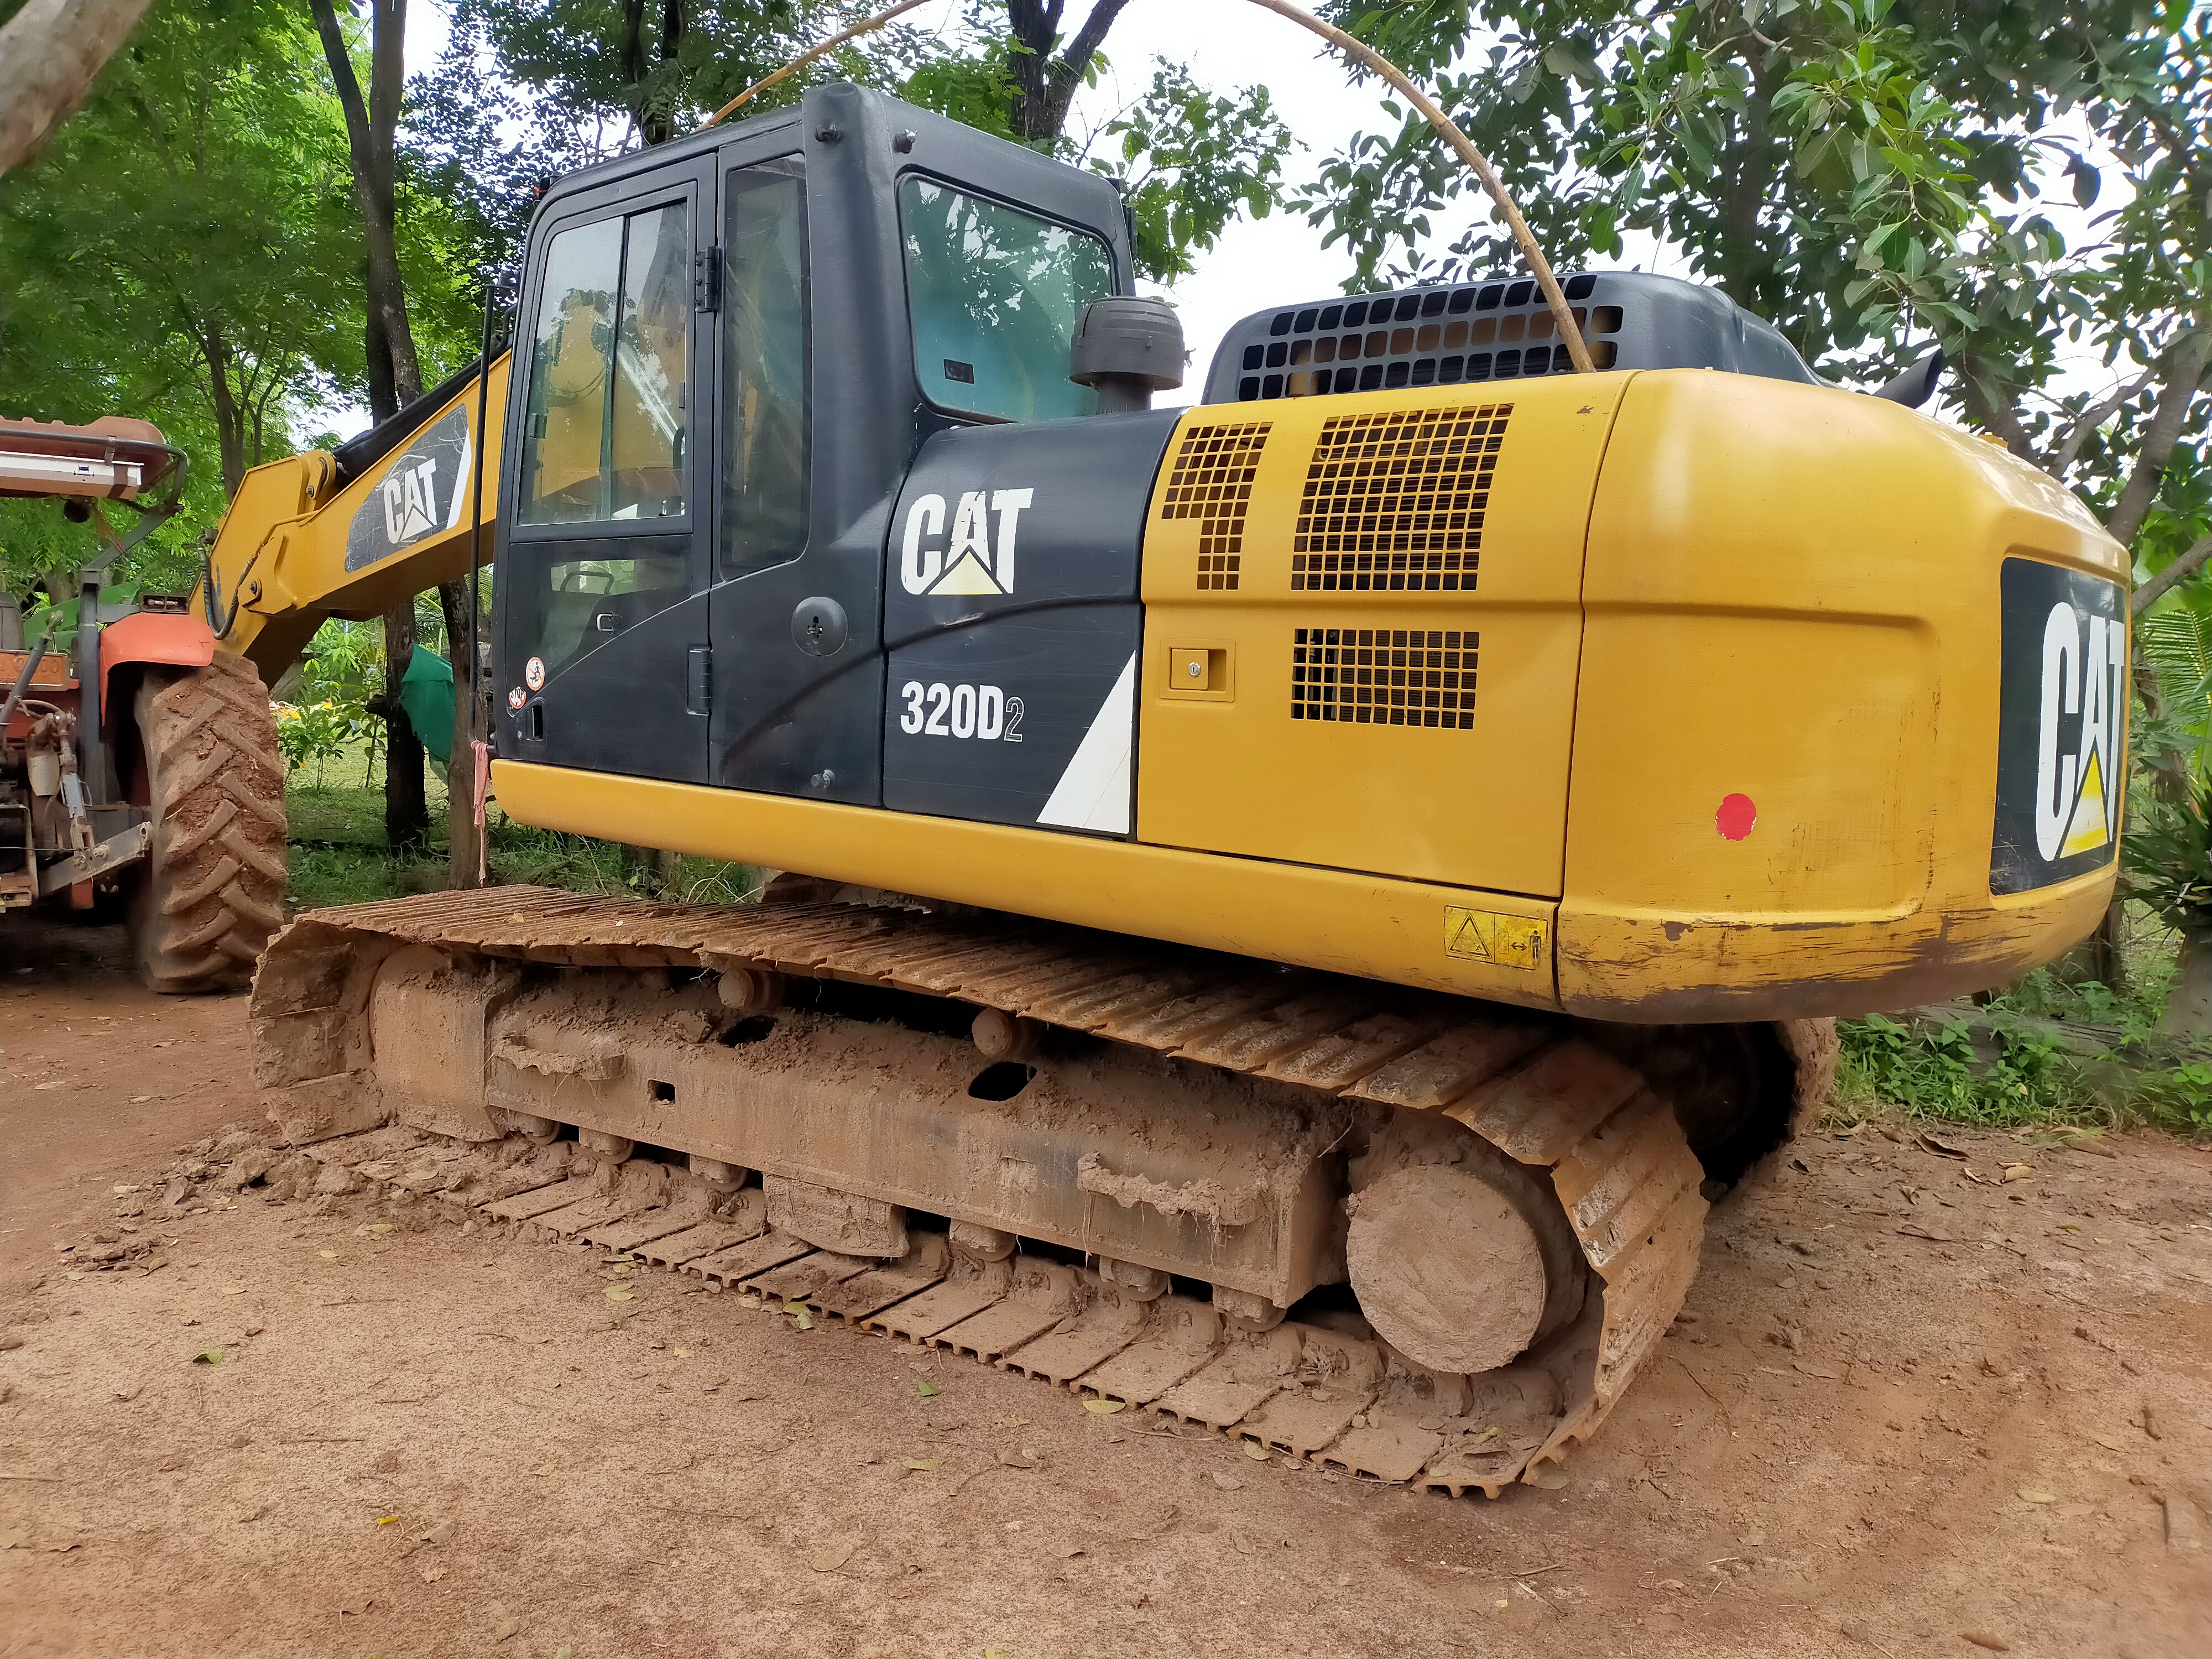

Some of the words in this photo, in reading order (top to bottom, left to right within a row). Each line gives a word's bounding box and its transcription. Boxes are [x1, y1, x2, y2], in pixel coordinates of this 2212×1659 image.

[383, 457, 437, 544] CAT
[901, 488, 1034, 596] CAT
[900, 681, 1025, 742] 320D2
[2036, 602, 2126, 862] CAT
